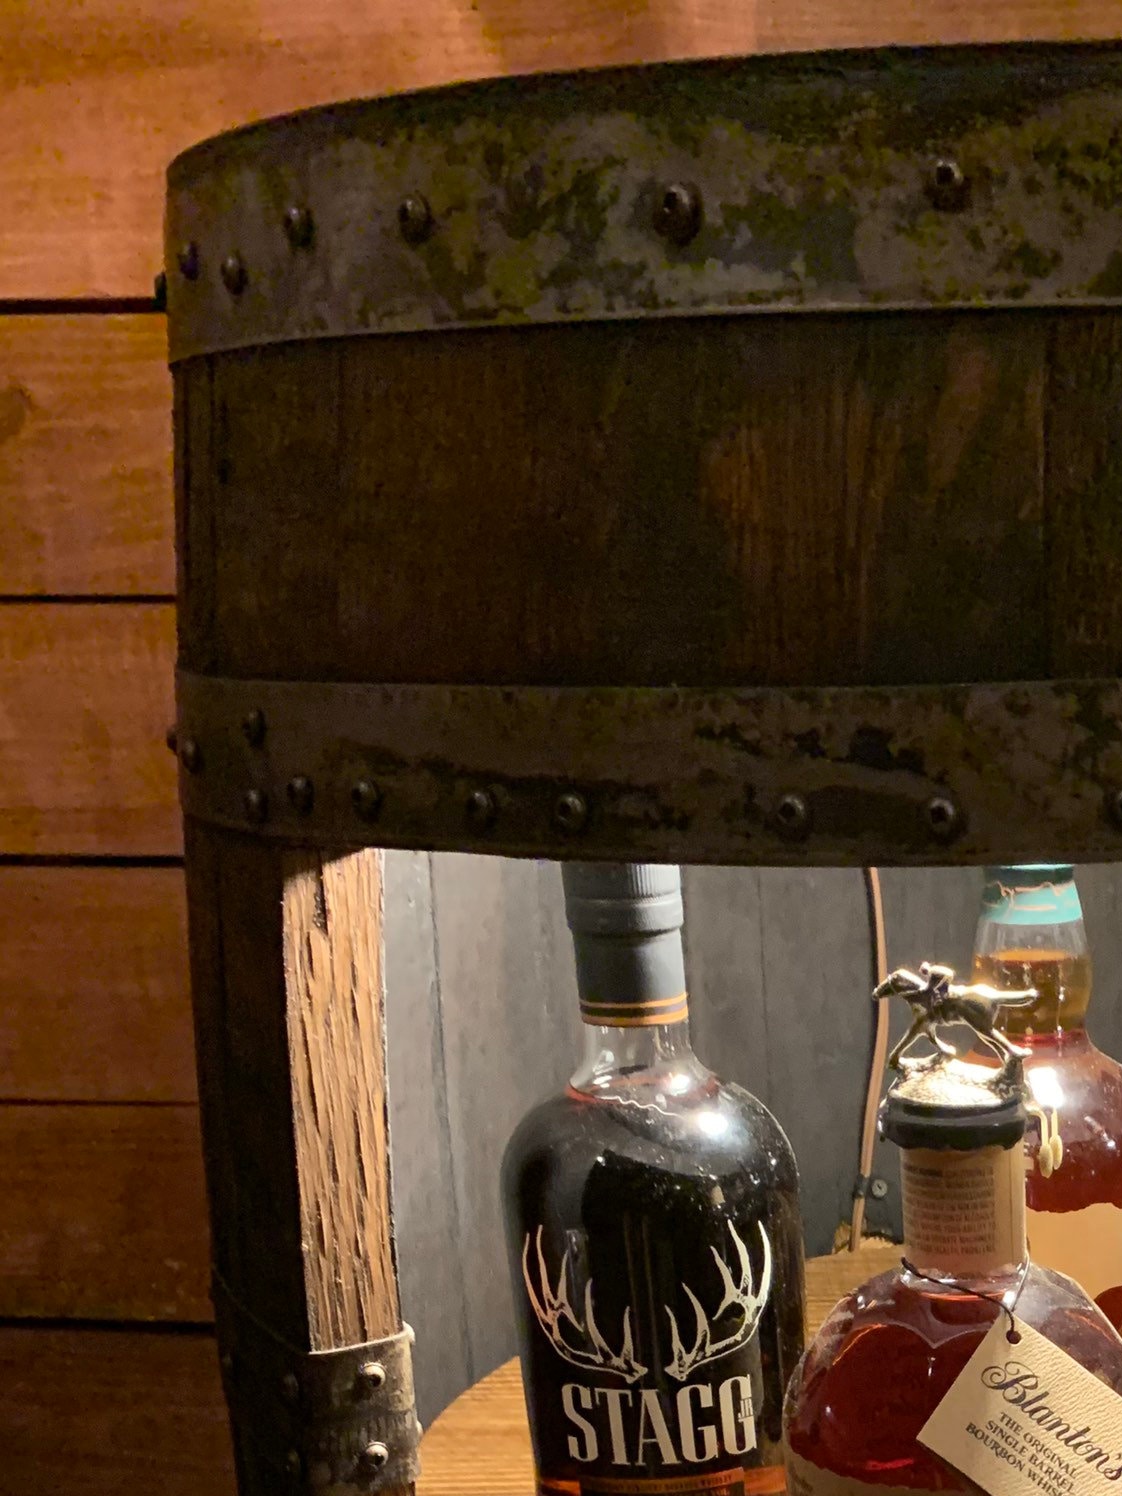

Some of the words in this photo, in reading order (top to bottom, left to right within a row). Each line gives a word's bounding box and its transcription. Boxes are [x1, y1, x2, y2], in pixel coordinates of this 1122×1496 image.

[561, 1373, 757, 1466] STAGG
[965, 1422, 1026, 1472] BOURBON
[1000, 1412, 1023, 1436] THE
[1023, 1432, 1078, 1480] ORIGINAL
[985, 1420, 1029, 1457] SINGLE
[1029, 1454, 1076, 1496] BARREL
